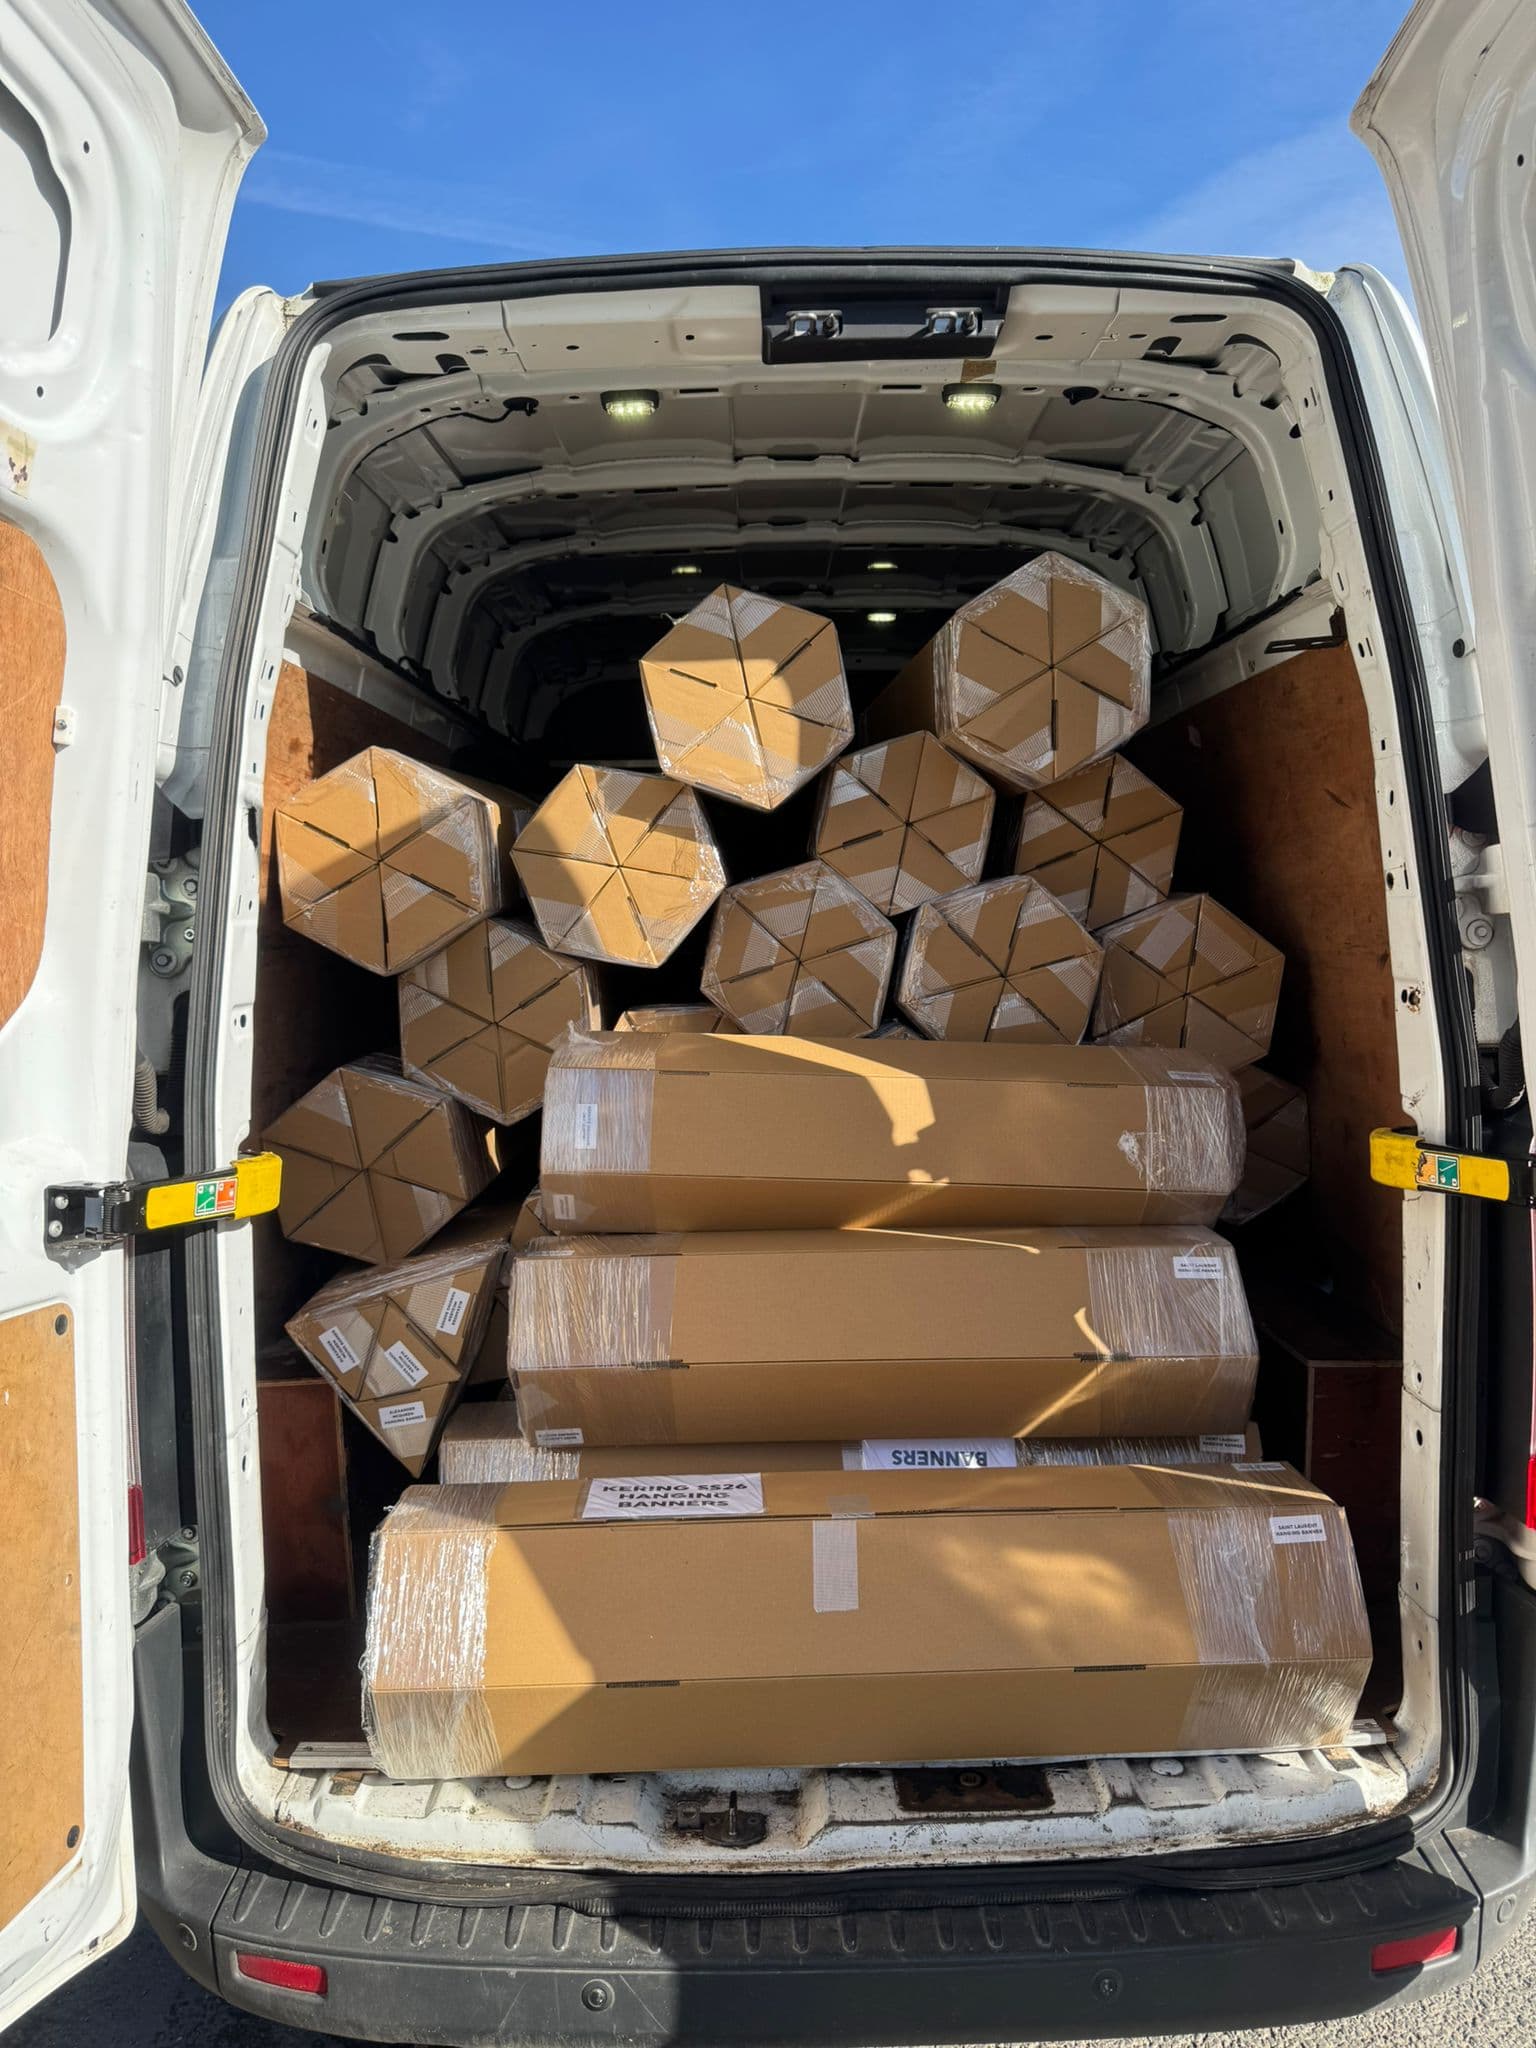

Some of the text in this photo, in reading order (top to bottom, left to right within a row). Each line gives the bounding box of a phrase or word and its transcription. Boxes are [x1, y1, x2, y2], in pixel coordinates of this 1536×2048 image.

[892, 1449, 988, 1467] BANNERS
[697, 1483, 748, 1491] SS26
[618, 1500, 729, 1508] BANNERS
